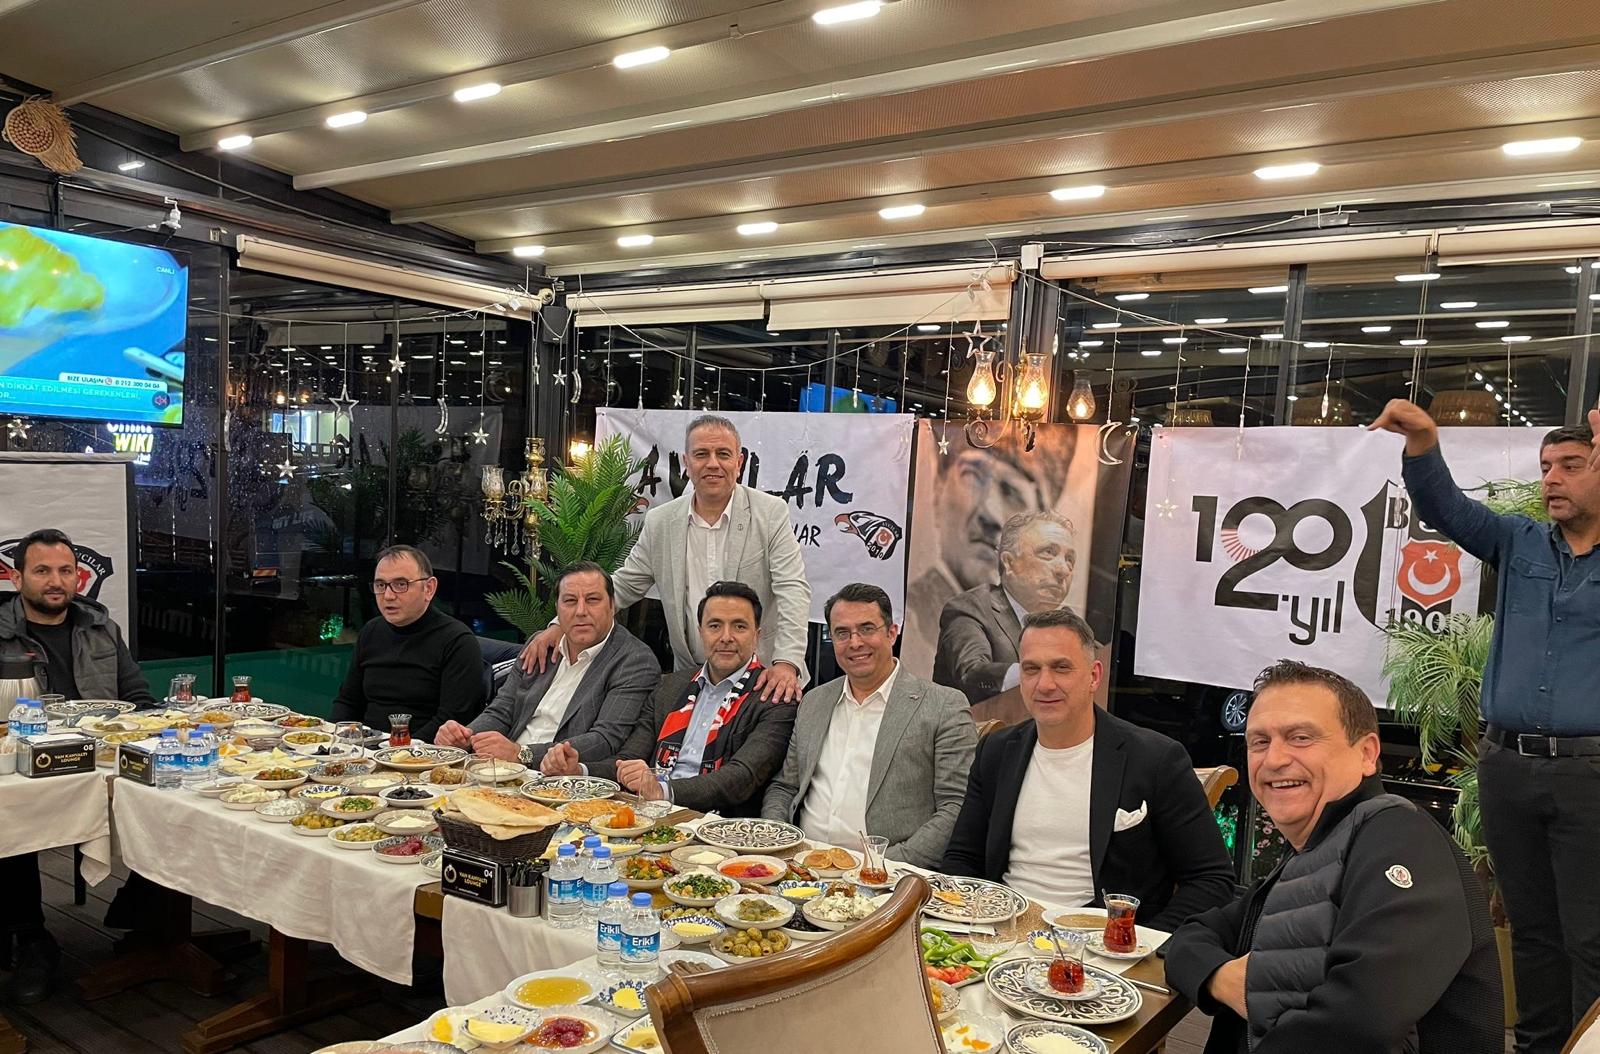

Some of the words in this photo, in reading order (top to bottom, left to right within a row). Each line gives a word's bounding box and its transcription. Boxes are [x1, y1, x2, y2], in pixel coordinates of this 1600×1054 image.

[867, 541, 884, 559] 2010
[483, 869, 493, 879] 04
[600, 924, 621, 935] Erikli
